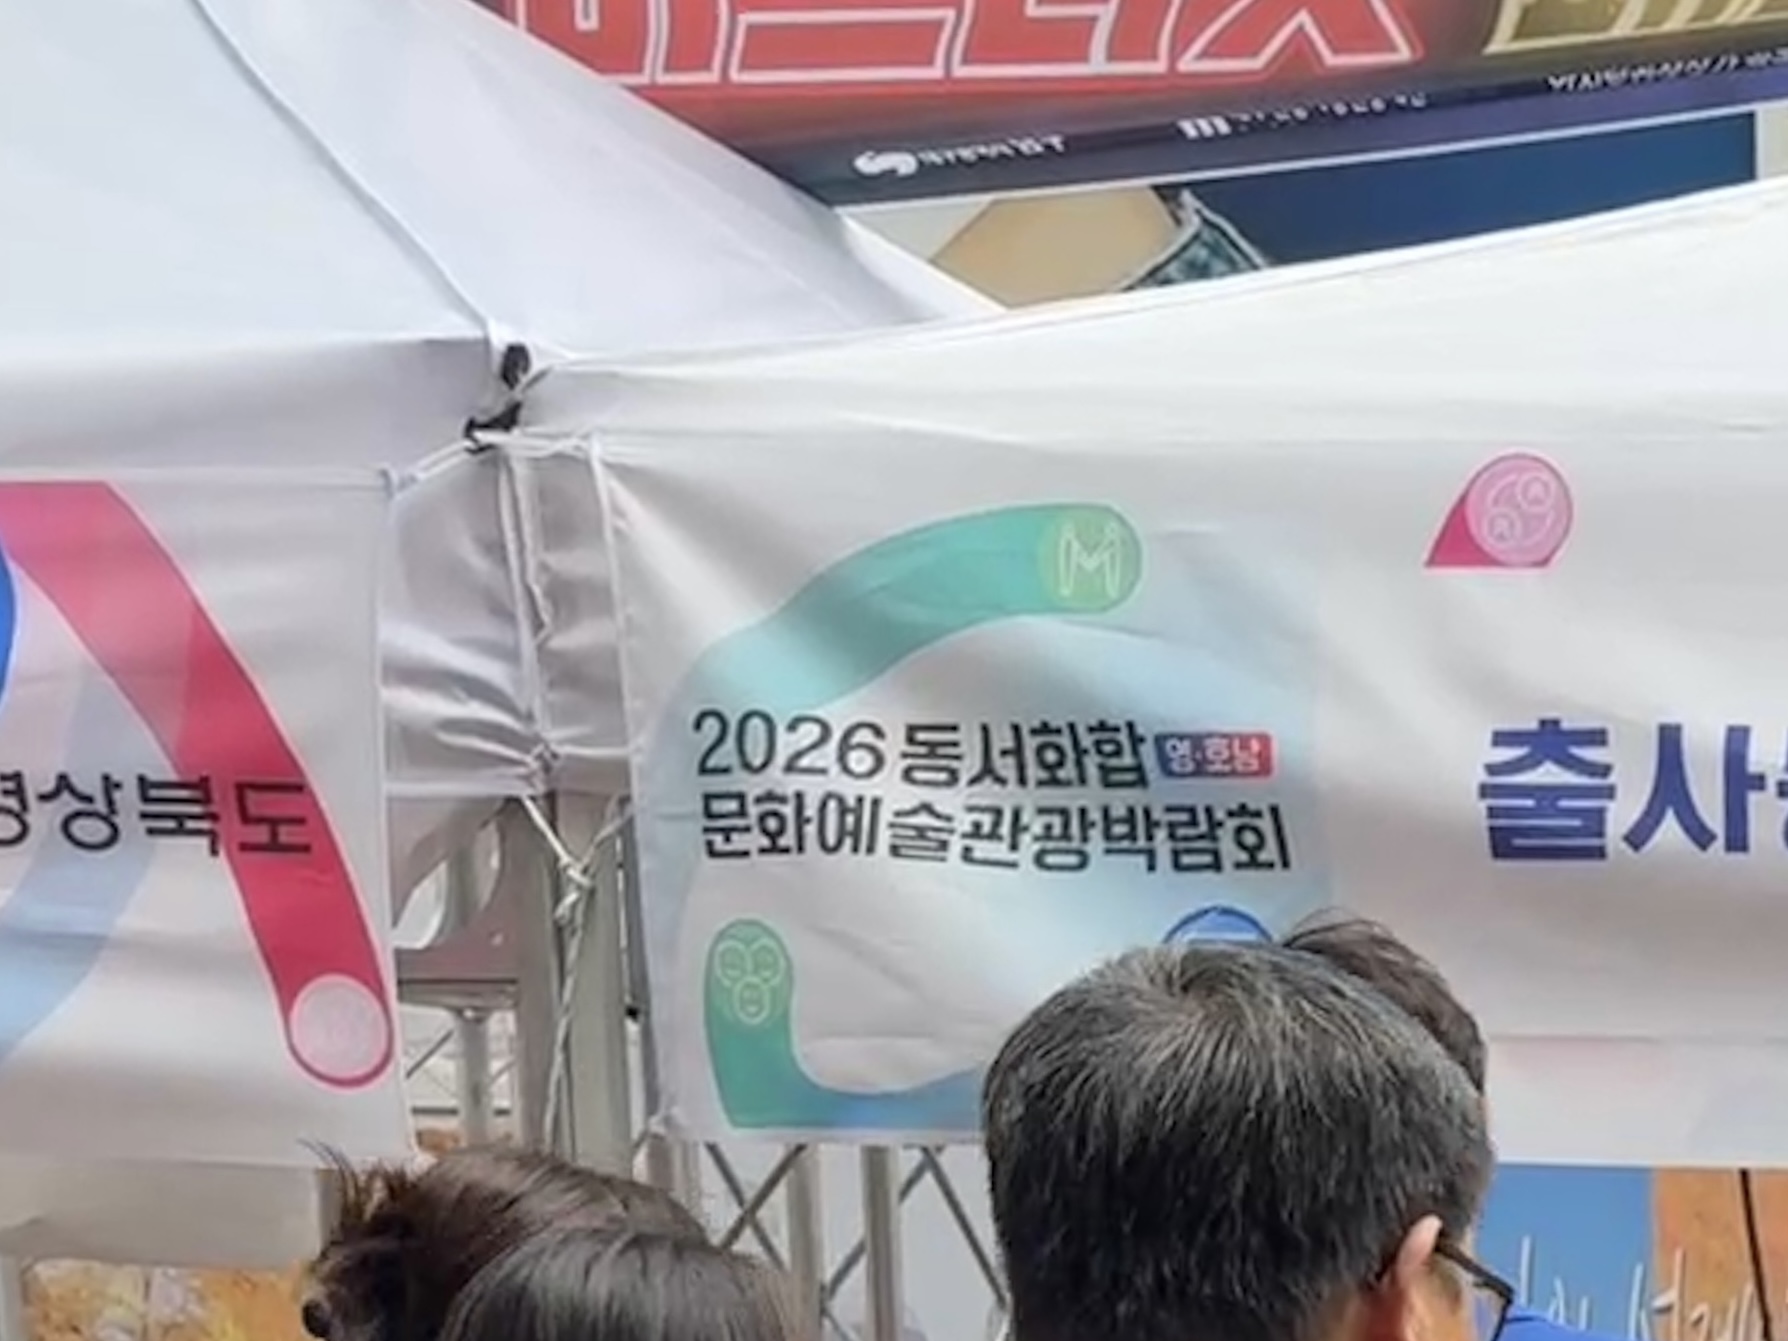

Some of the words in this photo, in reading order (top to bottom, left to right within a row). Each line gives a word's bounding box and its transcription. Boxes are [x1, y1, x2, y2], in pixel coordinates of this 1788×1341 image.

[693, 709, 887, 779] 2026
[900, 720, 1149, 789] 동서화합
[702, 789, 1293, 872] 문화예술관광박람회
